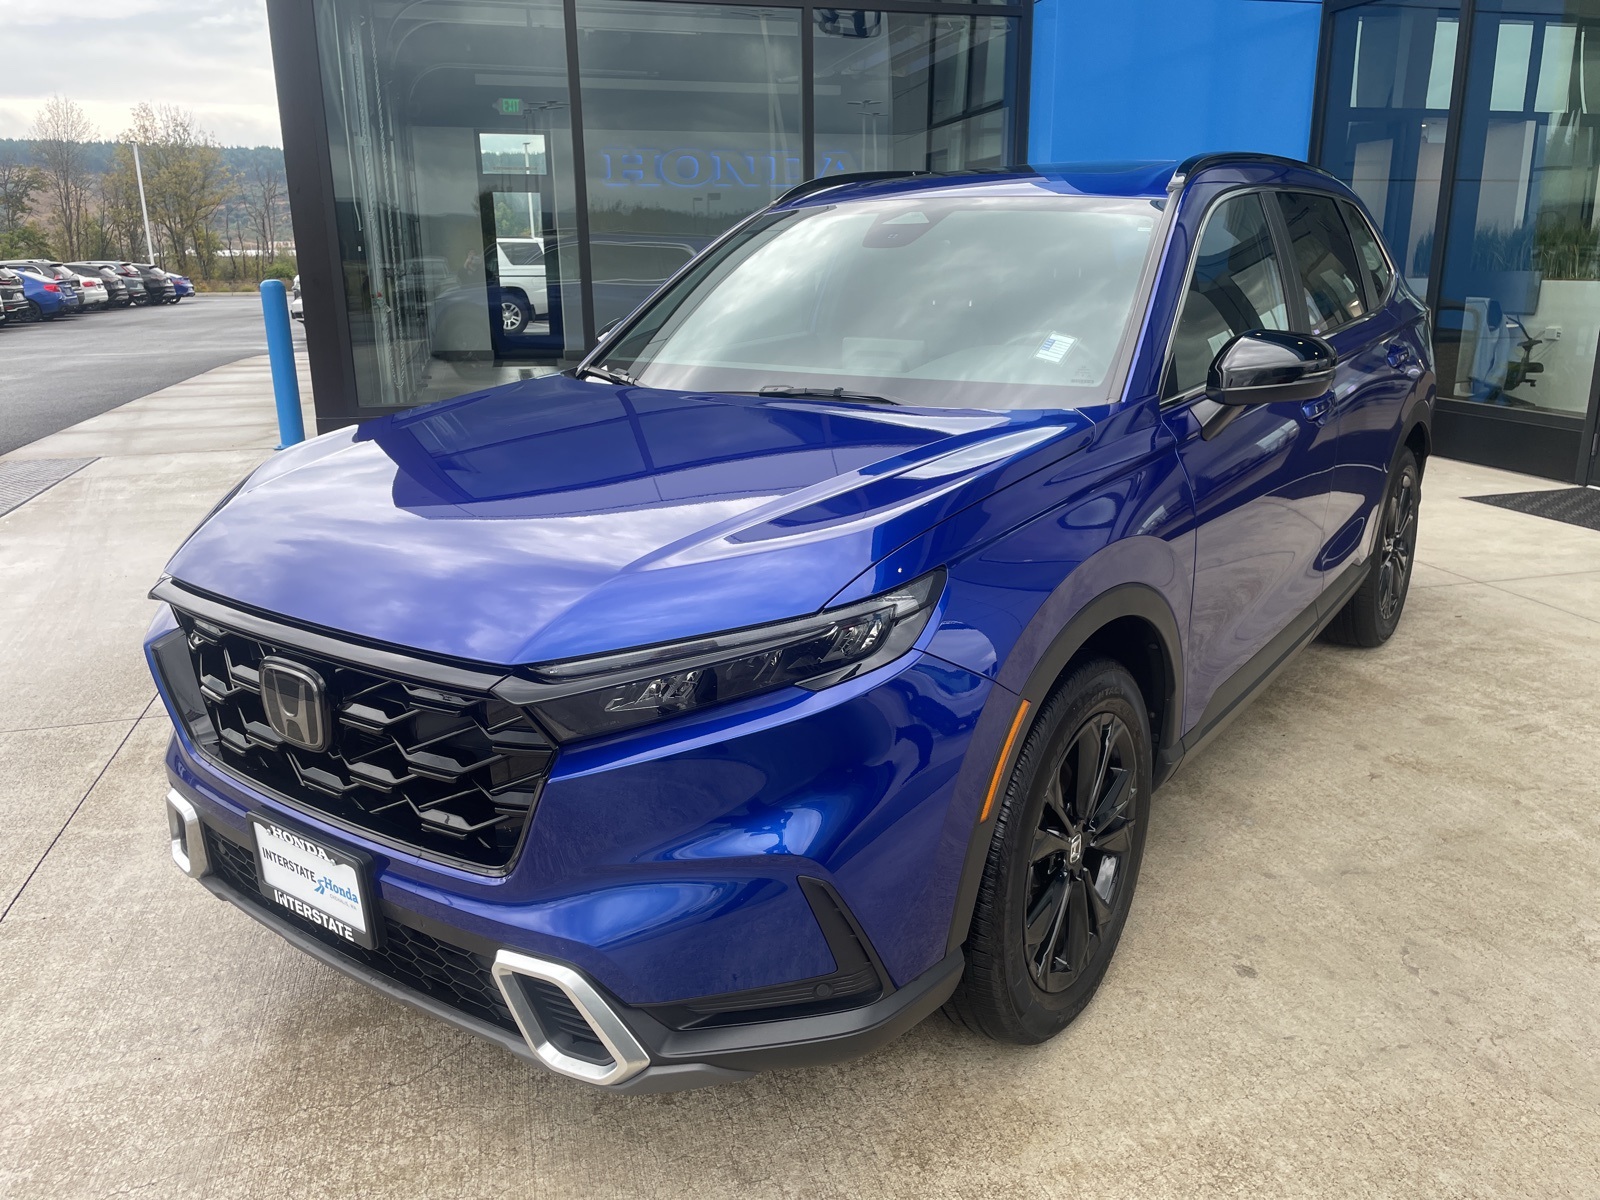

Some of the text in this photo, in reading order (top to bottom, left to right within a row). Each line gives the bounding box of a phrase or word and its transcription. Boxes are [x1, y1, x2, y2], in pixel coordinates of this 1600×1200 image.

[601, 149, 852, 187] HONDA
[270, 825, 331, 862] HONDA
[262, 847, 316, 883] INTERSTATE
[323, 877, 359, 904] Honda
[274, 889, 355, 942] INTERSTATE
